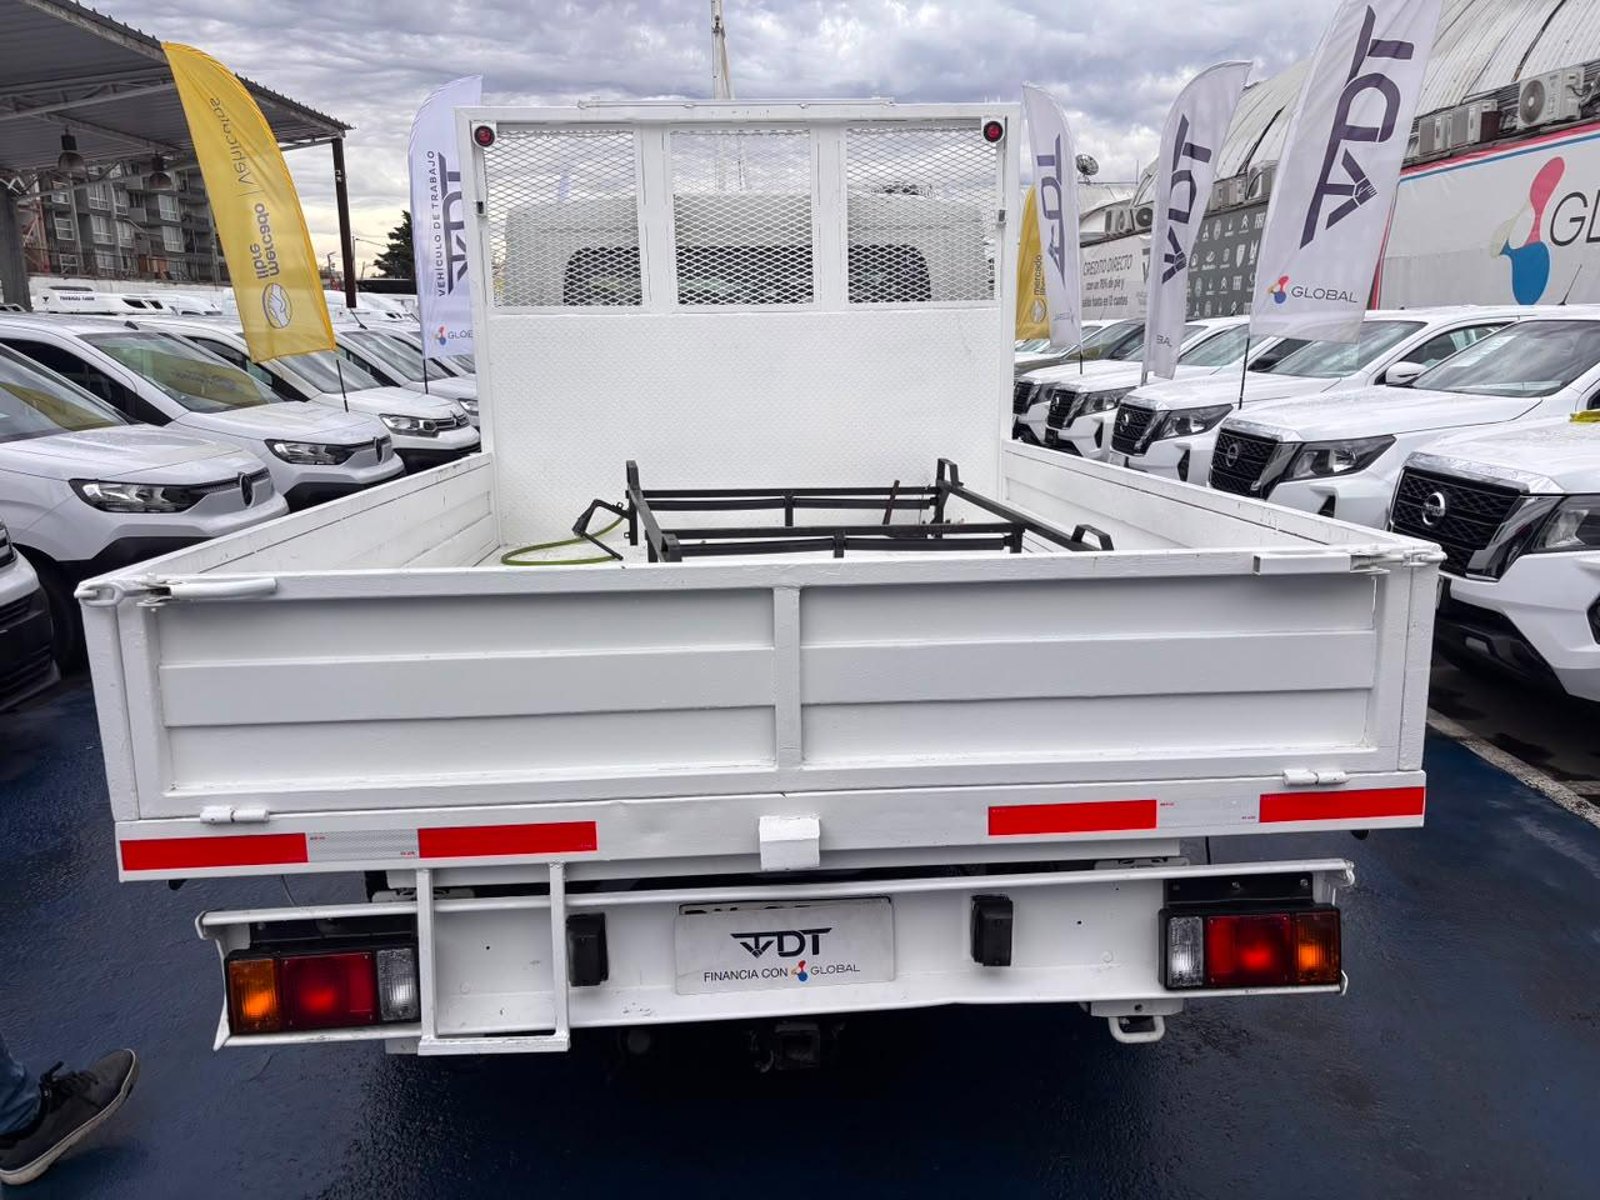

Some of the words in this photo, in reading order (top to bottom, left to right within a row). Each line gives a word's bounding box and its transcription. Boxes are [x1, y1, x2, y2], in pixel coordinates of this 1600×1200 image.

[426, 150, 439, 210] TRABAJO
[432, 213, 442, 230] DE
[1290, 285, 1358, 304] GLOBAL
[730, 927, 832, 959] VDT
[703, 969, 760, 983] FINANCIA
[760, 967, 788, 979] CON
[810, 963, 861, 976] GLOBAL
